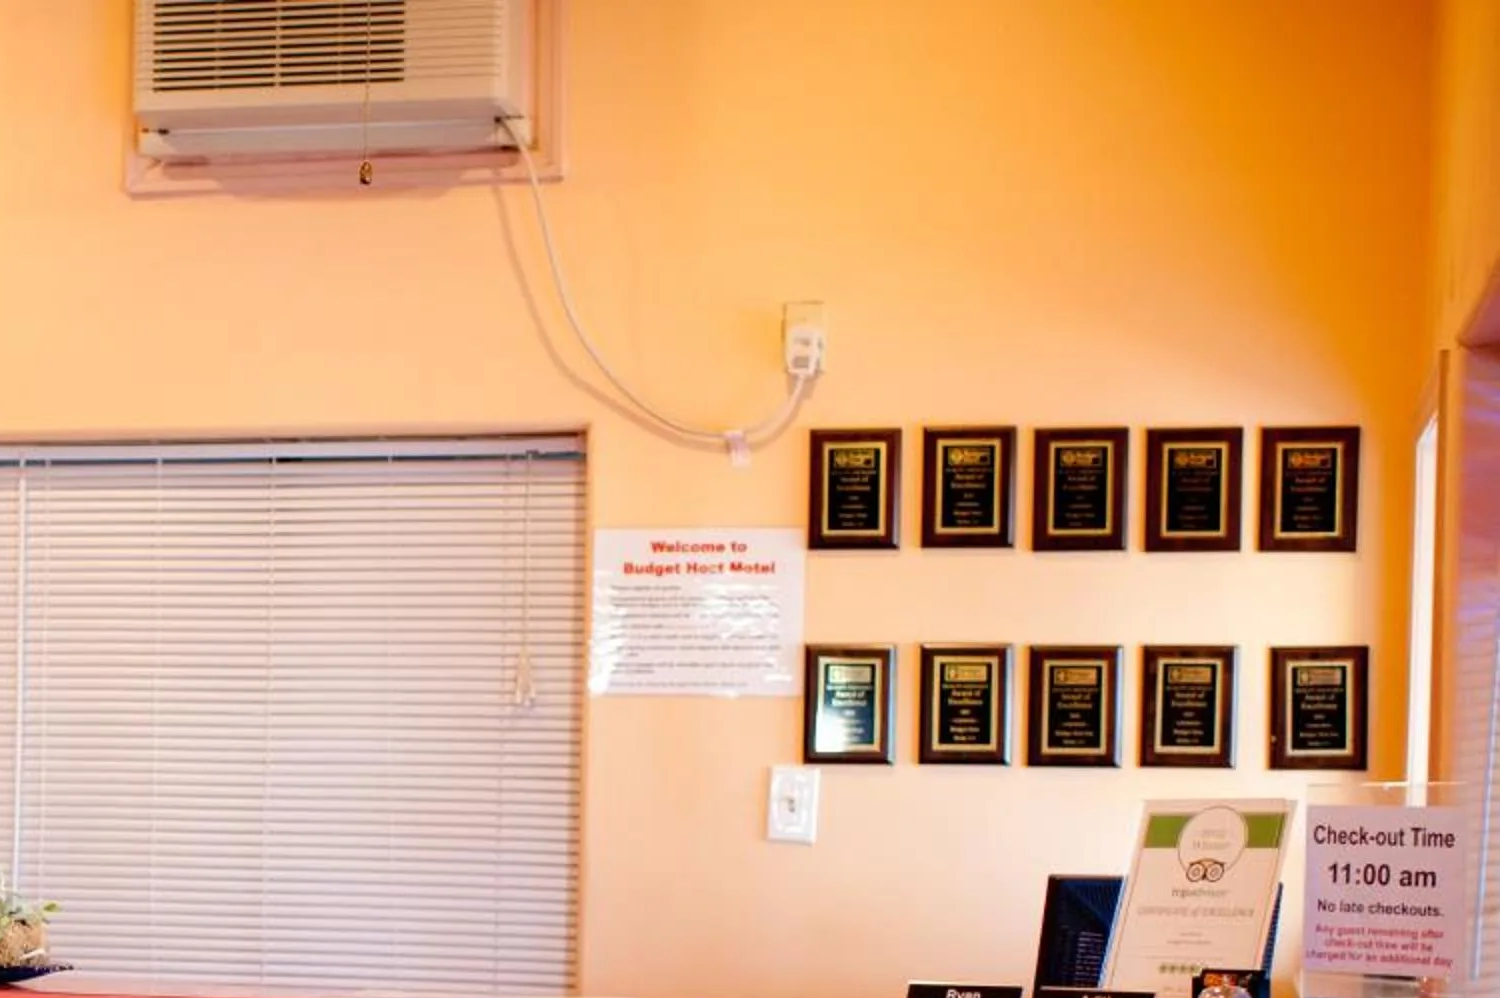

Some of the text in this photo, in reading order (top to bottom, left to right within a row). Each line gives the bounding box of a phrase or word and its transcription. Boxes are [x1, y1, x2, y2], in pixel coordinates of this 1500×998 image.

[650, 541, 748, 553] Welcome to
[623, 562, 680, 577] Budget
[730, 562, 775, 574] Motel
[1313, 825, 1456, 848] Check-out Time
[1328, 863, 1437, 887] 11:00 am
[1317, 899, 1336, 912] No
[1339, 900, 1364, 913] late
